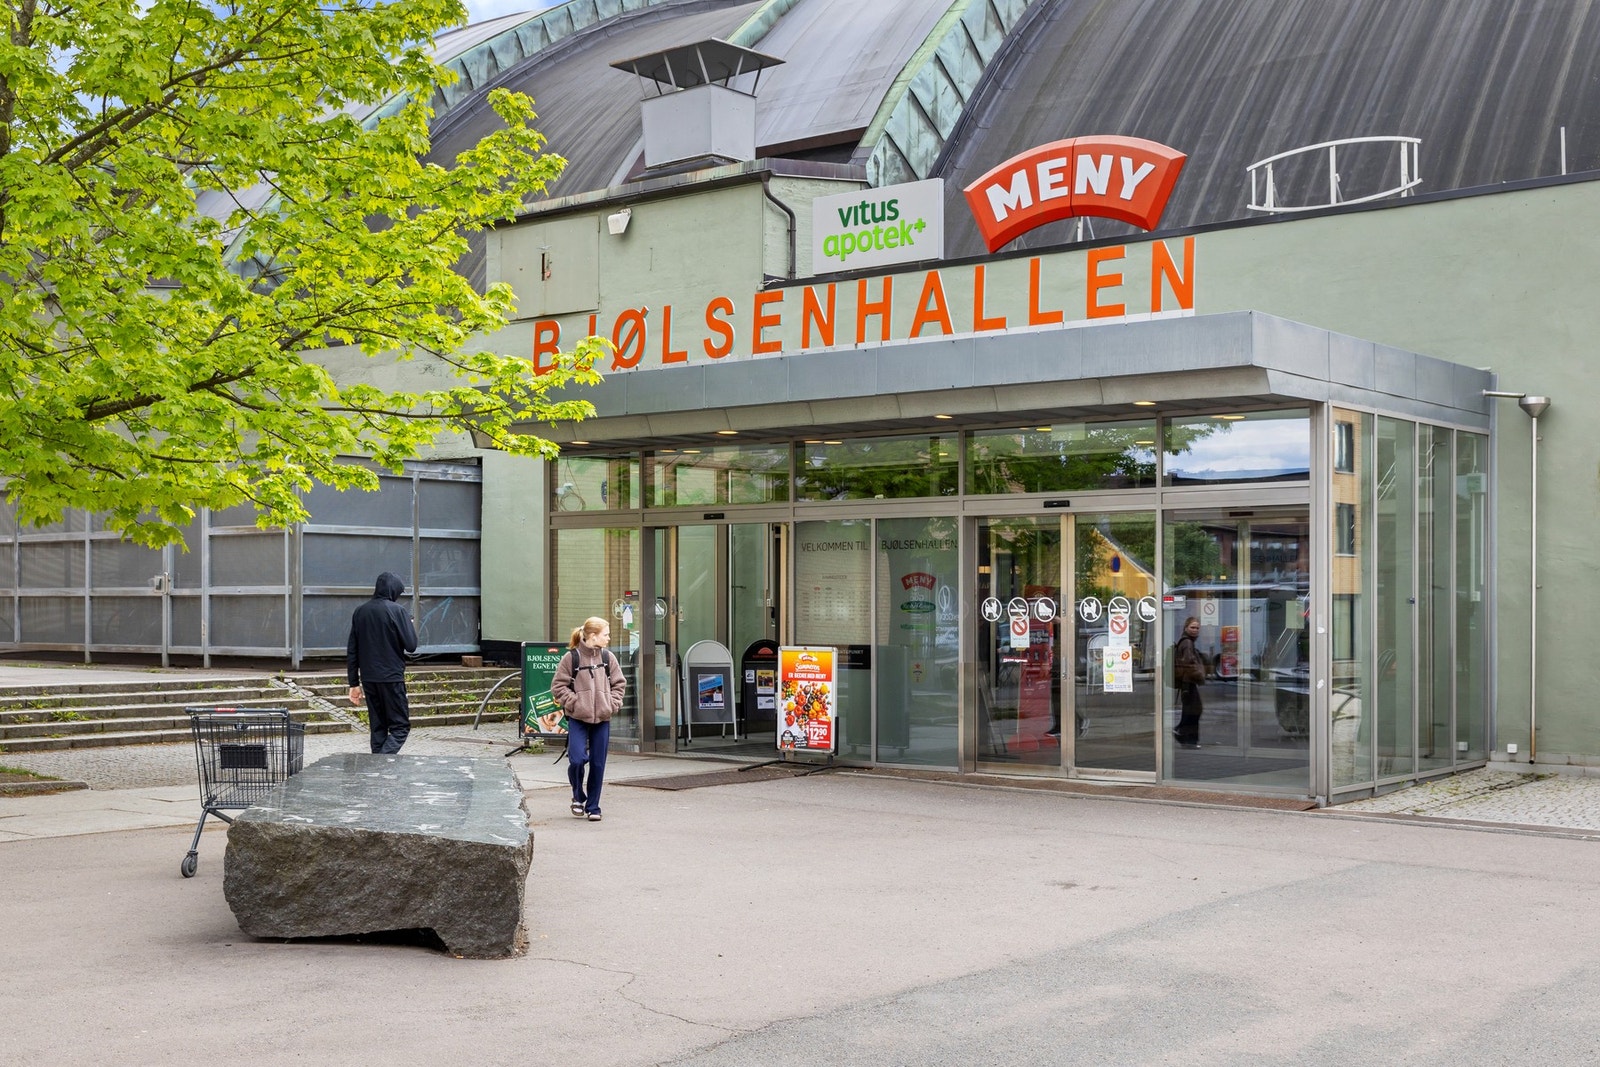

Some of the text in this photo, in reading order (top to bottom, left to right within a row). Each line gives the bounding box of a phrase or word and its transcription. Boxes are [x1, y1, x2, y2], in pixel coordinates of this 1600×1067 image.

[985, 154, 1156, 223] MENY
[838, 199, 899, 228] vitus
[801, 539, 958, 552] VELKOMMEN TIL BJØLSENHALLEN
[905, 575, 933, 587] MENY
[532, 662, 552, 670] EGNE
